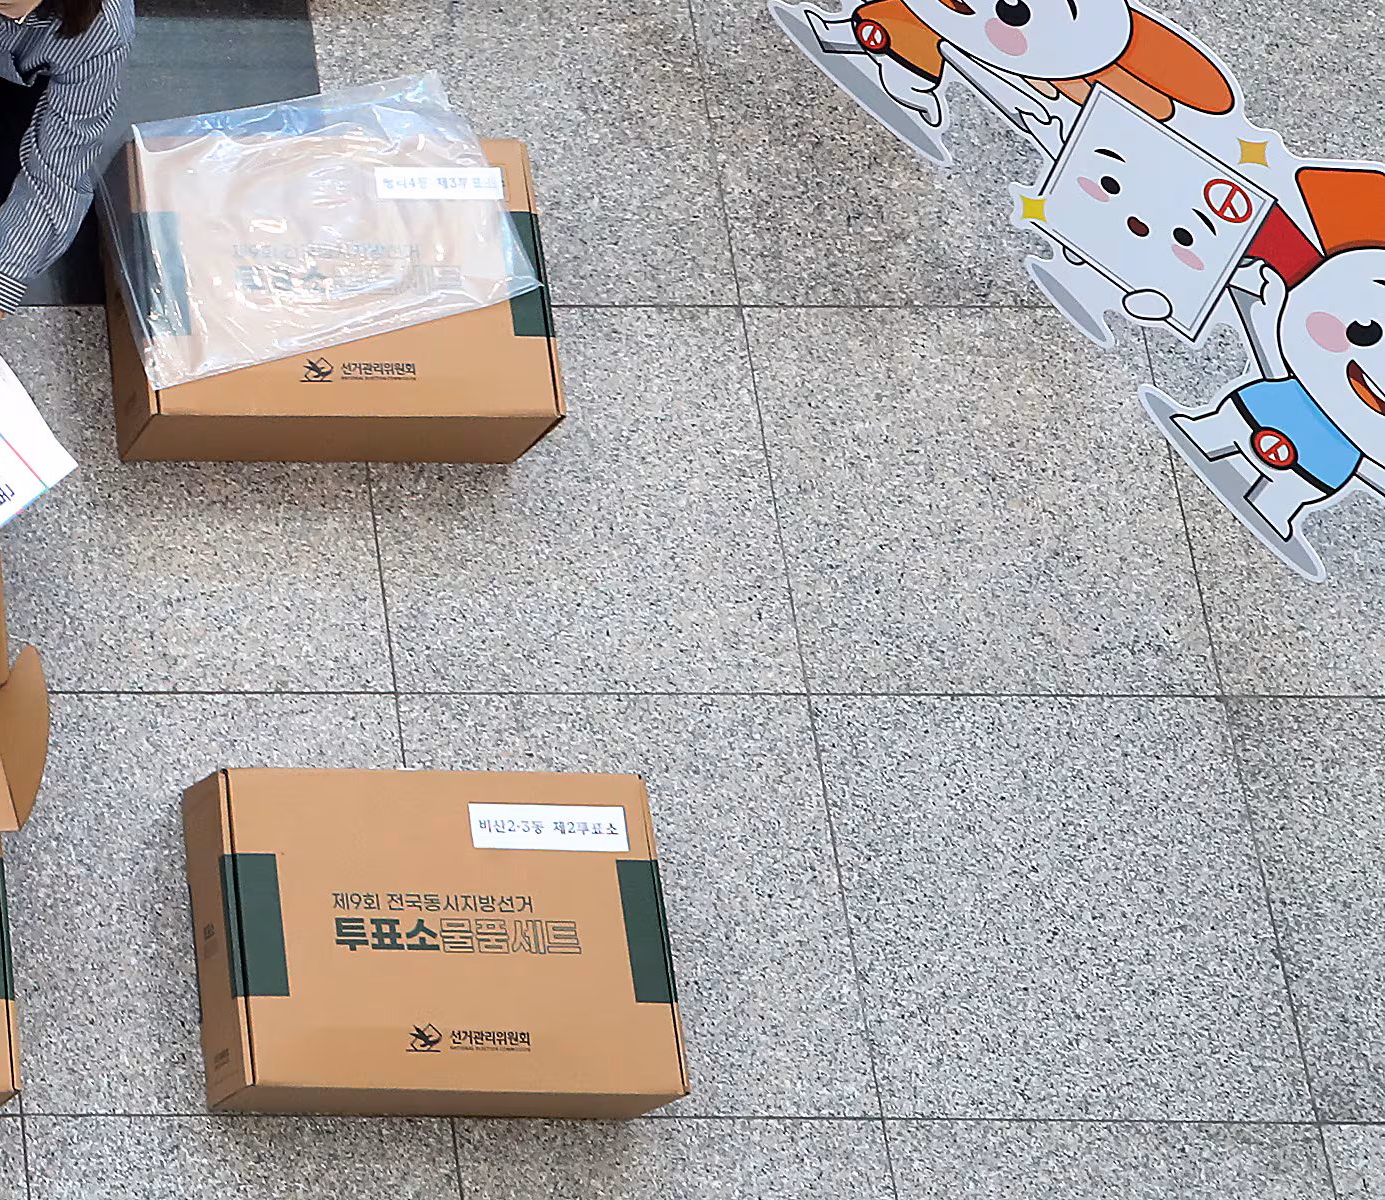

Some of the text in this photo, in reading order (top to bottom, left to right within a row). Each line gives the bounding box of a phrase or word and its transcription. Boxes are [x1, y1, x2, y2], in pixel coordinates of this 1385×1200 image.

[341, 362, 416, 377] 선거관리위원회
[333, 893, 533, 913] 제9회 전국동시지방선거
[334, 917, 581, 955] 투표소물품세트
[449, 1029, 531, 1046] 선거관리위원회
